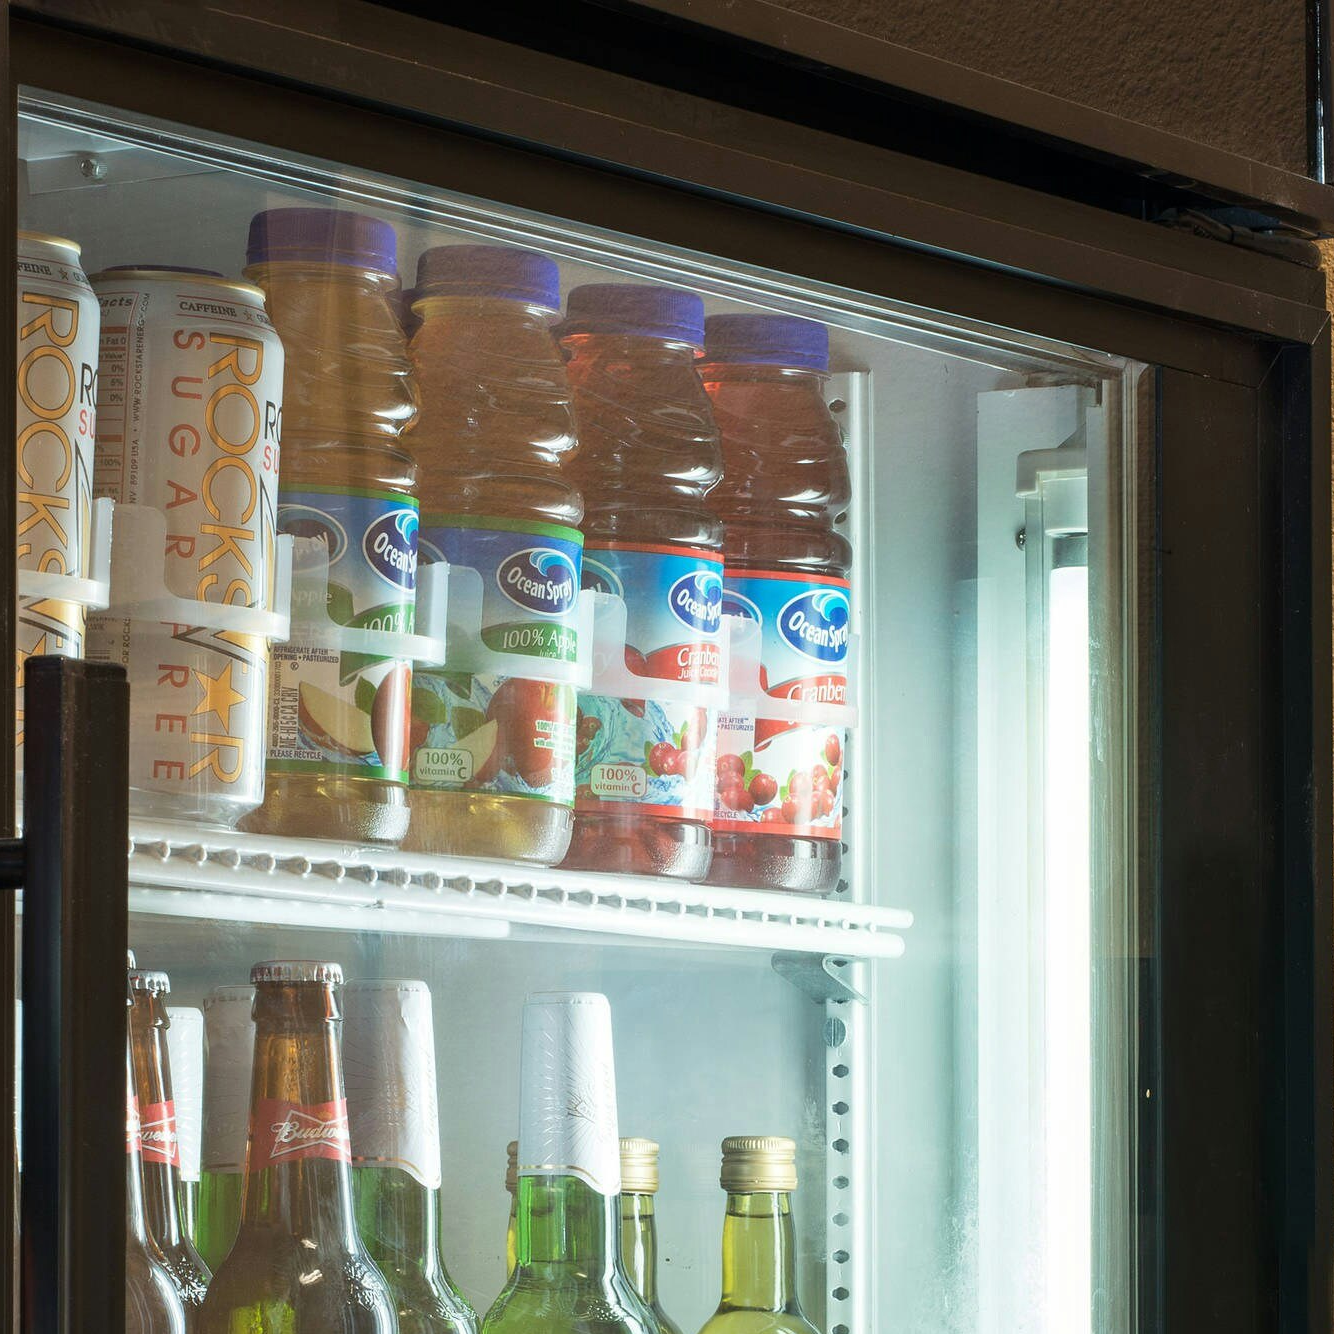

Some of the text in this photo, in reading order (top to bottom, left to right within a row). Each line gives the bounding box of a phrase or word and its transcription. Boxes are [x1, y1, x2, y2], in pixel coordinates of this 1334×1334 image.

[178, 301, 237, 318] CAFFEINE
[164, 328, 207, 560] SUGAR
[373, 532, 409, 574] Ocean
[507, 566, 573, 606] Ocean Spray
[677, 588, 708, 621] Ocean
[788, 610, 828, 647] Ocean
[502, 628, 545, 649] 100%
[294, 750, 323, 760] RECYCLE
[424, 751, 464, 766] 100%
[419, 766, 468, 780] vitamin C
[600, 767, 637, 782] 100%
[594, 781, 641, 796] vitamin C
